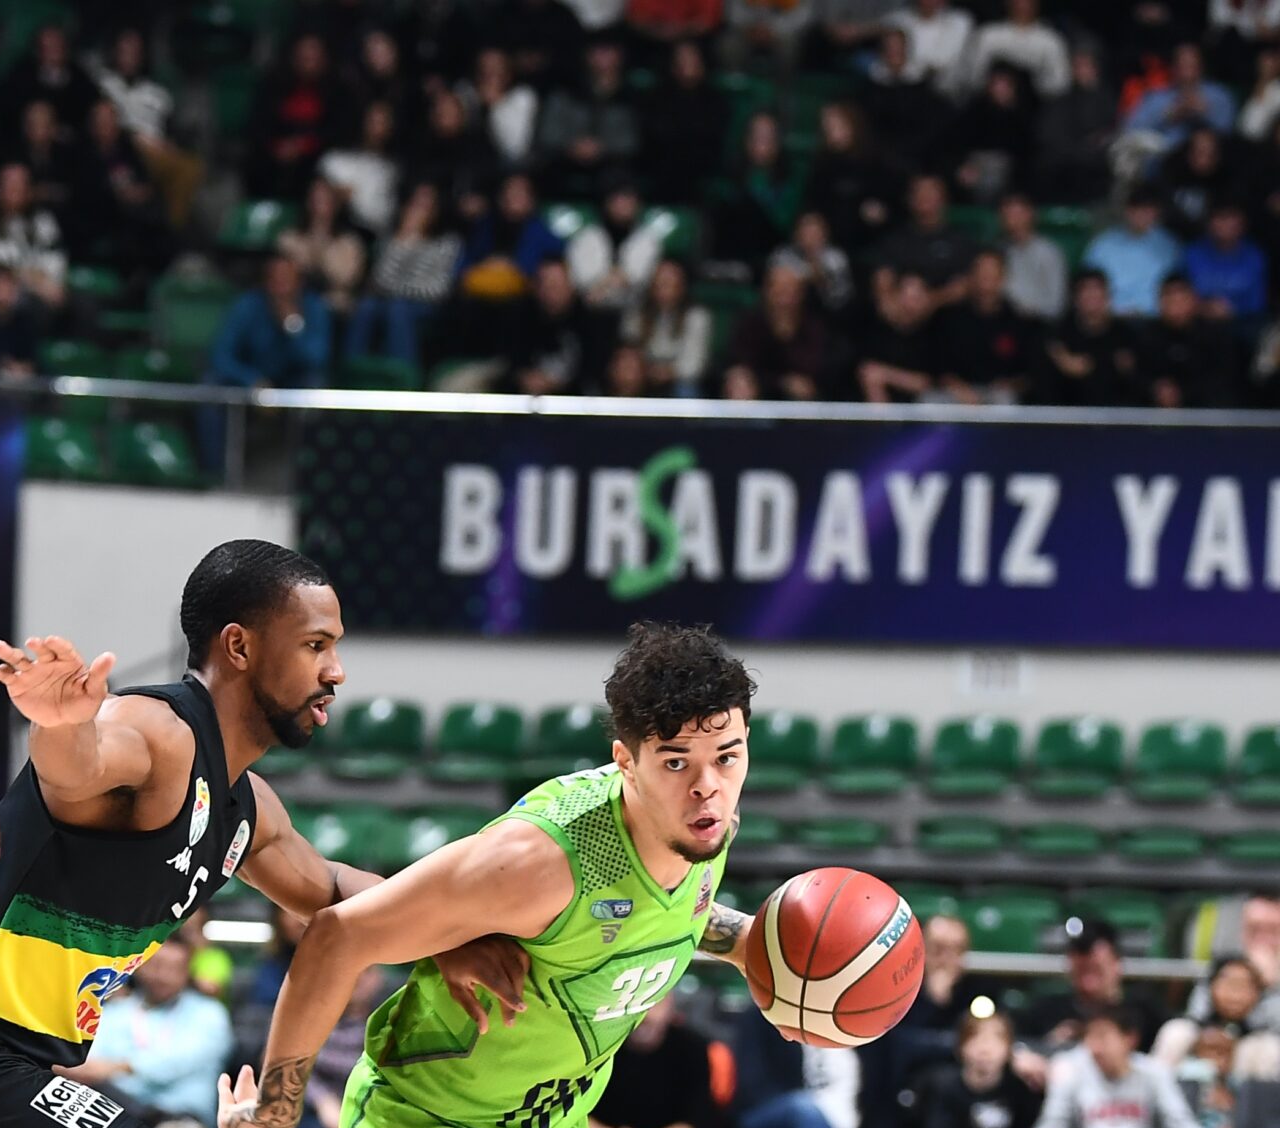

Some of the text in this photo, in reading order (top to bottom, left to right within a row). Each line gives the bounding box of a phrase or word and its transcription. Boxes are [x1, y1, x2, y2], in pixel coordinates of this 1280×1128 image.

[440, 446, 1062, 600] BURSADAYIZ
[171, 866, 209, 919] 5
[592, 957, 676, 1022] 32
[34, 1081, 80, 1116] Ken
[56, 1089, 96, 1124] Meyda
